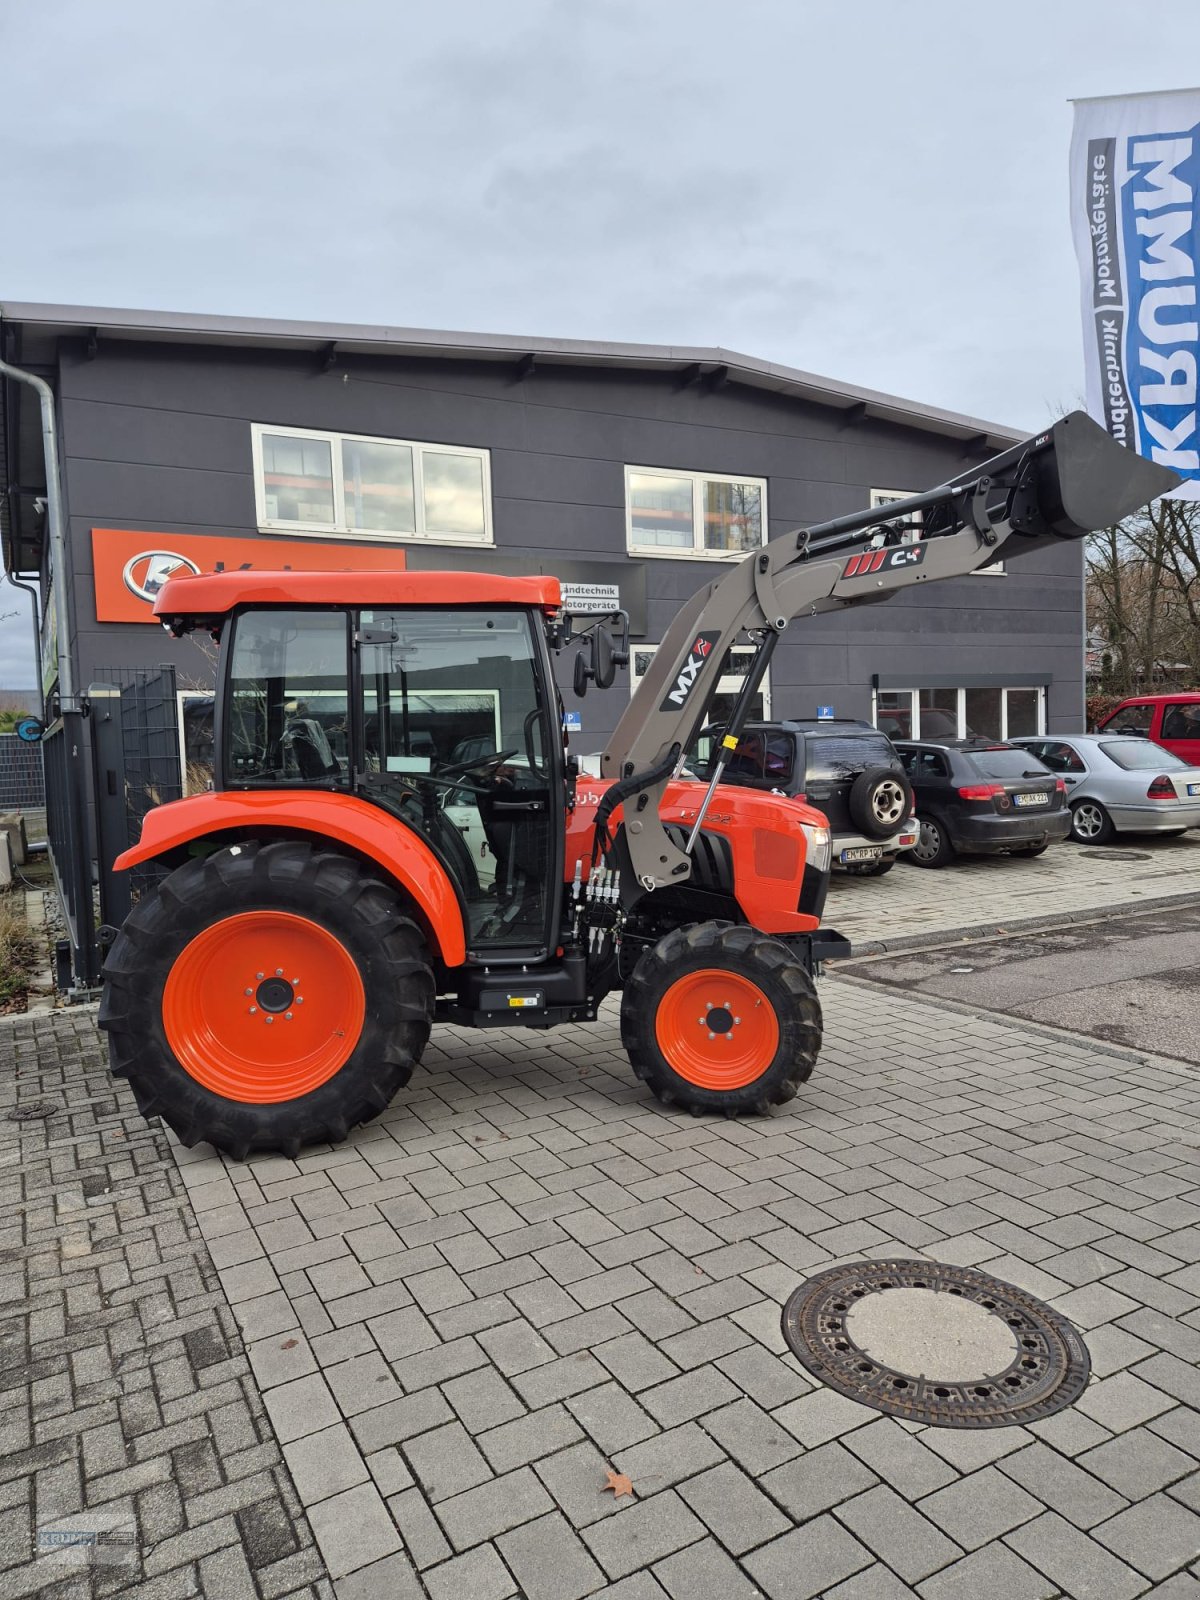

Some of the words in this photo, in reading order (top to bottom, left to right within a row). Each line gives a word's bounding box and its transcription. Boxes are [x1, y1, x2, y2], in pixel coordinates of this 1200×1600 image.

[563, 584, 616, 595] andtechnik
[567, 601, 617, 611] otorgeräte
[668, 653, 704, 705] MX
